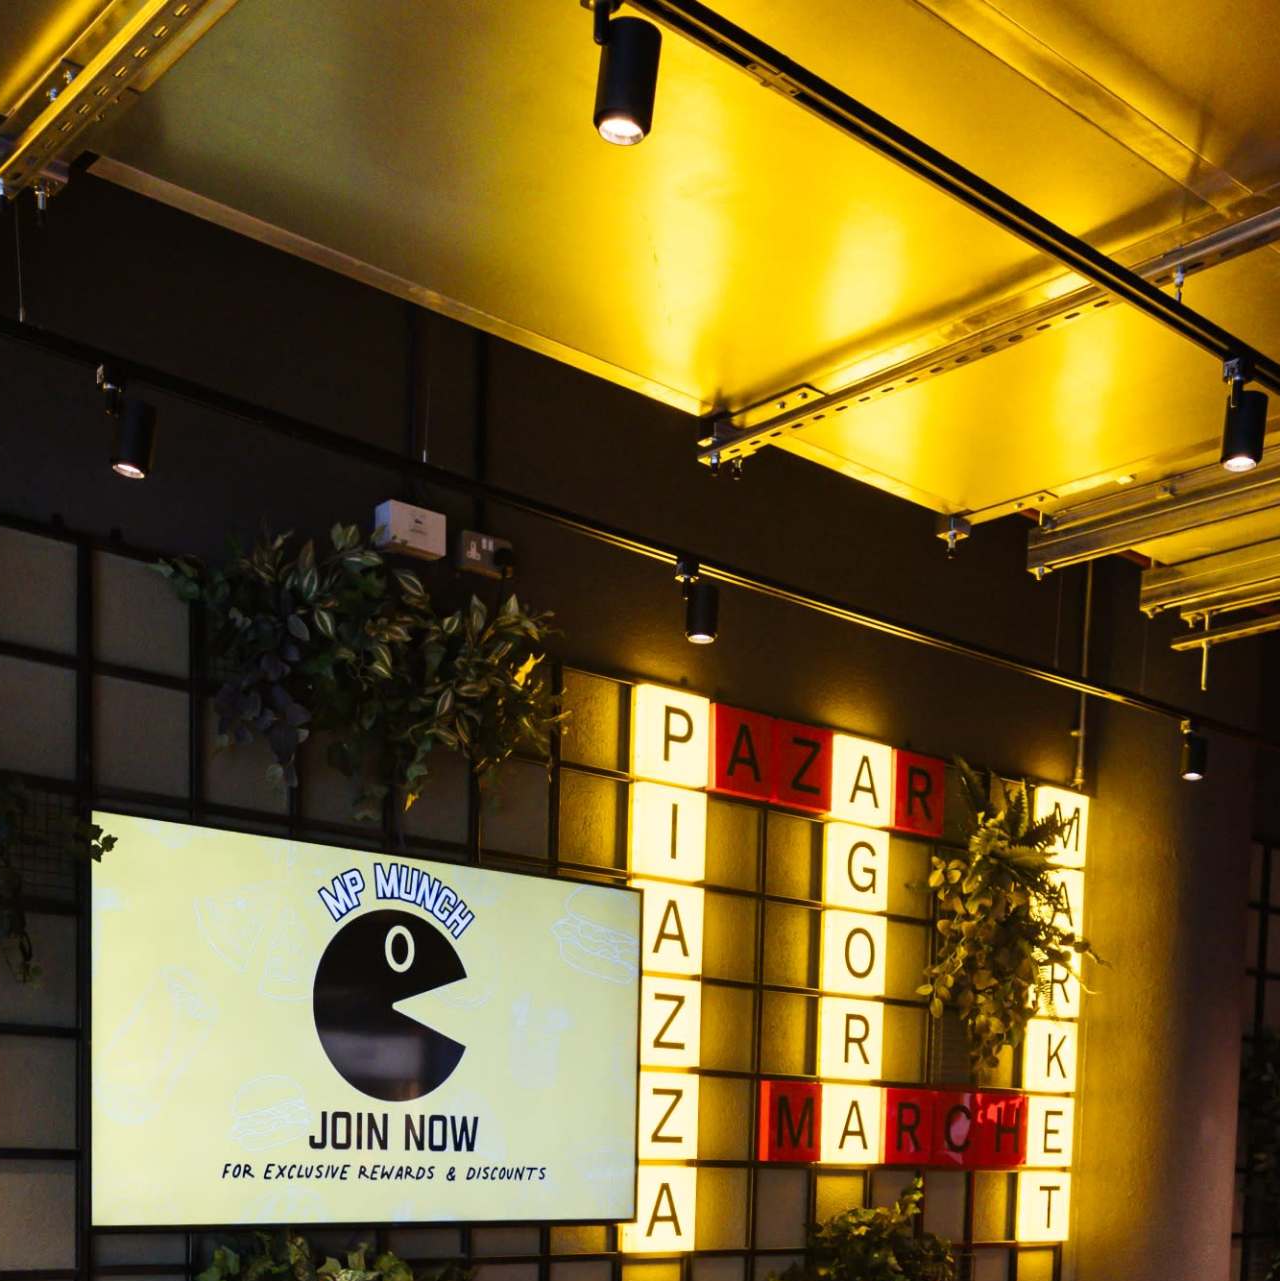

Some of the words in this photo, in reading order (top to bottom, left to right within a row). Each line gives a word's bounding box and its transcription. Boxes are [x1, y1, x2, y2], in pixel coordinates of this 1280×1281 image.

[664, 705, 934, 821] PAZAR
[317, 867, 366, 923] MP
[373, 862, 476, 940] MUNCH
[646, 705, 695, 1238] PIAZZA
[839, 755, 880, 1151] AGORA
[222, 1163, 255, 1180] FOR
[263, 1162, 351, 1181] EXCLUSIVE
[358, 1164, 436, 1181] REWARDS
[446, 1165, 457, 1182] &
[466, 1165, 547, 1182] DISCOUNTS
[309, 1111, 389, 1151] JOIN
[404, 1113, 479, 1152] NOW
